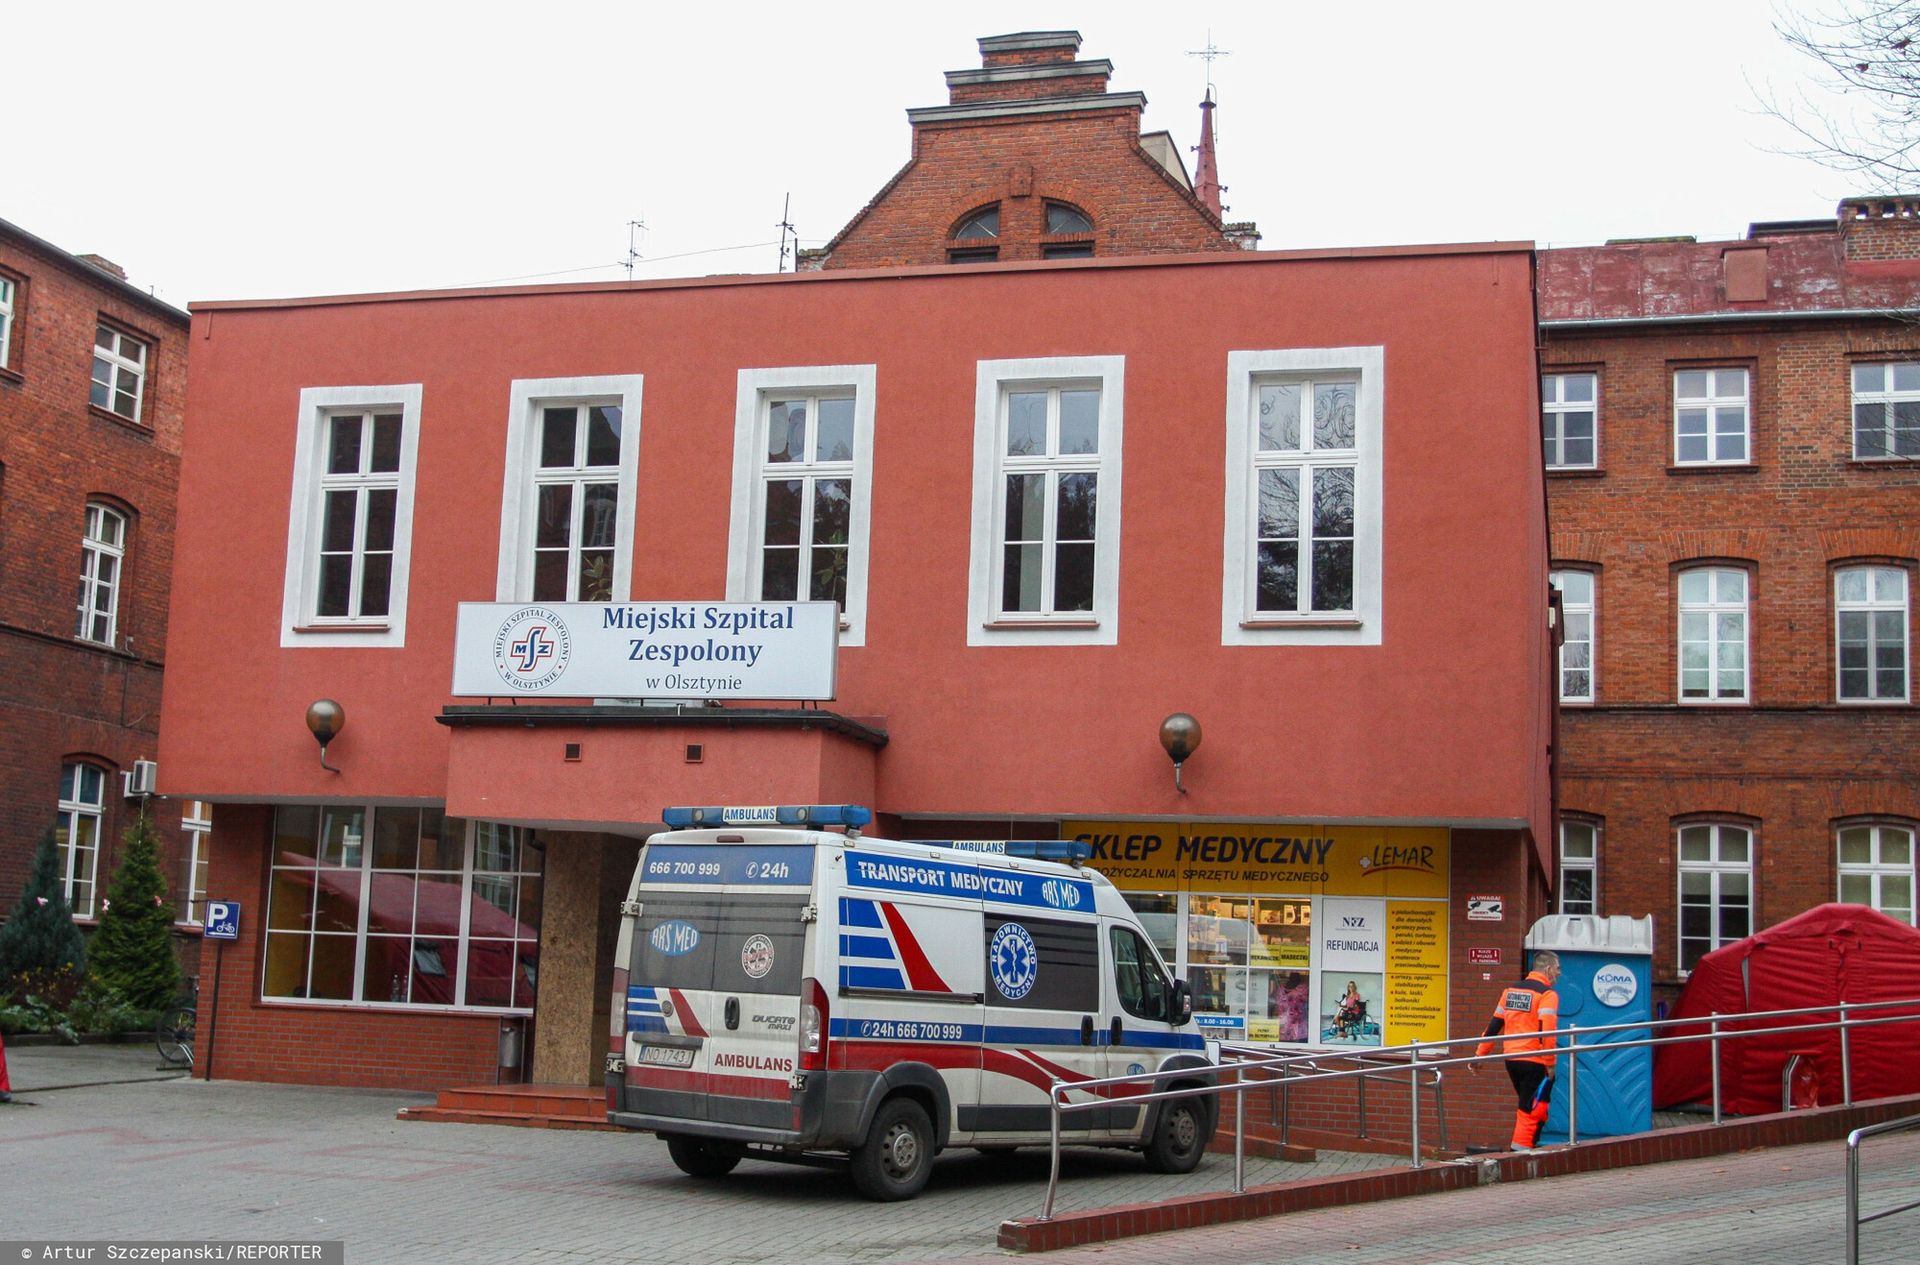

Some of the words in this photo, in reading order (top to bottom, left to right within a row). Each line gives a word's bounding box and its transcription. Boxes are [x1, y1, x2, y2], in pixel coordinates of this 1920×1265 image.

[602, 606, 696, 635] Miejski
[703, 606, 794, 635] Szpital
[496, 622, 512, 658] MIEJSKI
[511, 609, 545, 624] SZPITAL
[546, 613, 569, 662] ZESPOLONY
[628, 638, 763, 667] Zespolony
[504, 671, 513, 680] W
[513, 670, 559, 689] OLSZTYNIE
[646, 677, 660, 690] w
[664, 673, 742, 694] Olsztynie
[724, 808, 775, 821] AMBULANS
[953, 841, 1005, 853] AMBULANS
[1175, 835, 1335, 865] MEDYCZNY
[1373, 844, 1435, 869] LEMAR
[649, 861, 671, 874] 666
[674, 862, 696, 875] 700
[698, 862, 721, 876] 999
[760, 862, 789, 879] 24h
[857, 861, 945, 887] TRANSPORT
[951, 871, 1024, 897] MEDYCZNY
[1098, 866, 1176, 879] OŻYCZALNIA
[1182, 869, 1240, 882] SPRZĘTU
[1242, 870, 1330, 882] MEDYCZNEGO
[1042, 880, 1059, 907] ARS
[1059, 880, 1080, 908] MED
[208, 903, 229, 928] P
[1342, 916, 1366, 928] NFZ
[651, 924, 672, 952] ARS
[673, 924, 698, 953] MED
[992, 924, 1036, 965] RATOWNICTWO
[1326, 939, 1379, 952] REFUNDACJA
[995, 973, 1034, 997] MEDYCZNE
[1597, 973, 1633, 983] KOMA
[751, 1014, 796, 1025] DUCATO
[767, 1023, 792, 1031] MAXI
[872, 1021, 895, 1037] 24h
[896, 1023, 918, 1038] 666
[920, 1023, 940, 1039] 700
[942, 1024, 962, 1039] 999
[645, 1047, 660, 1061] NO
[714, 1053, 793, 1073] AMBULANS
